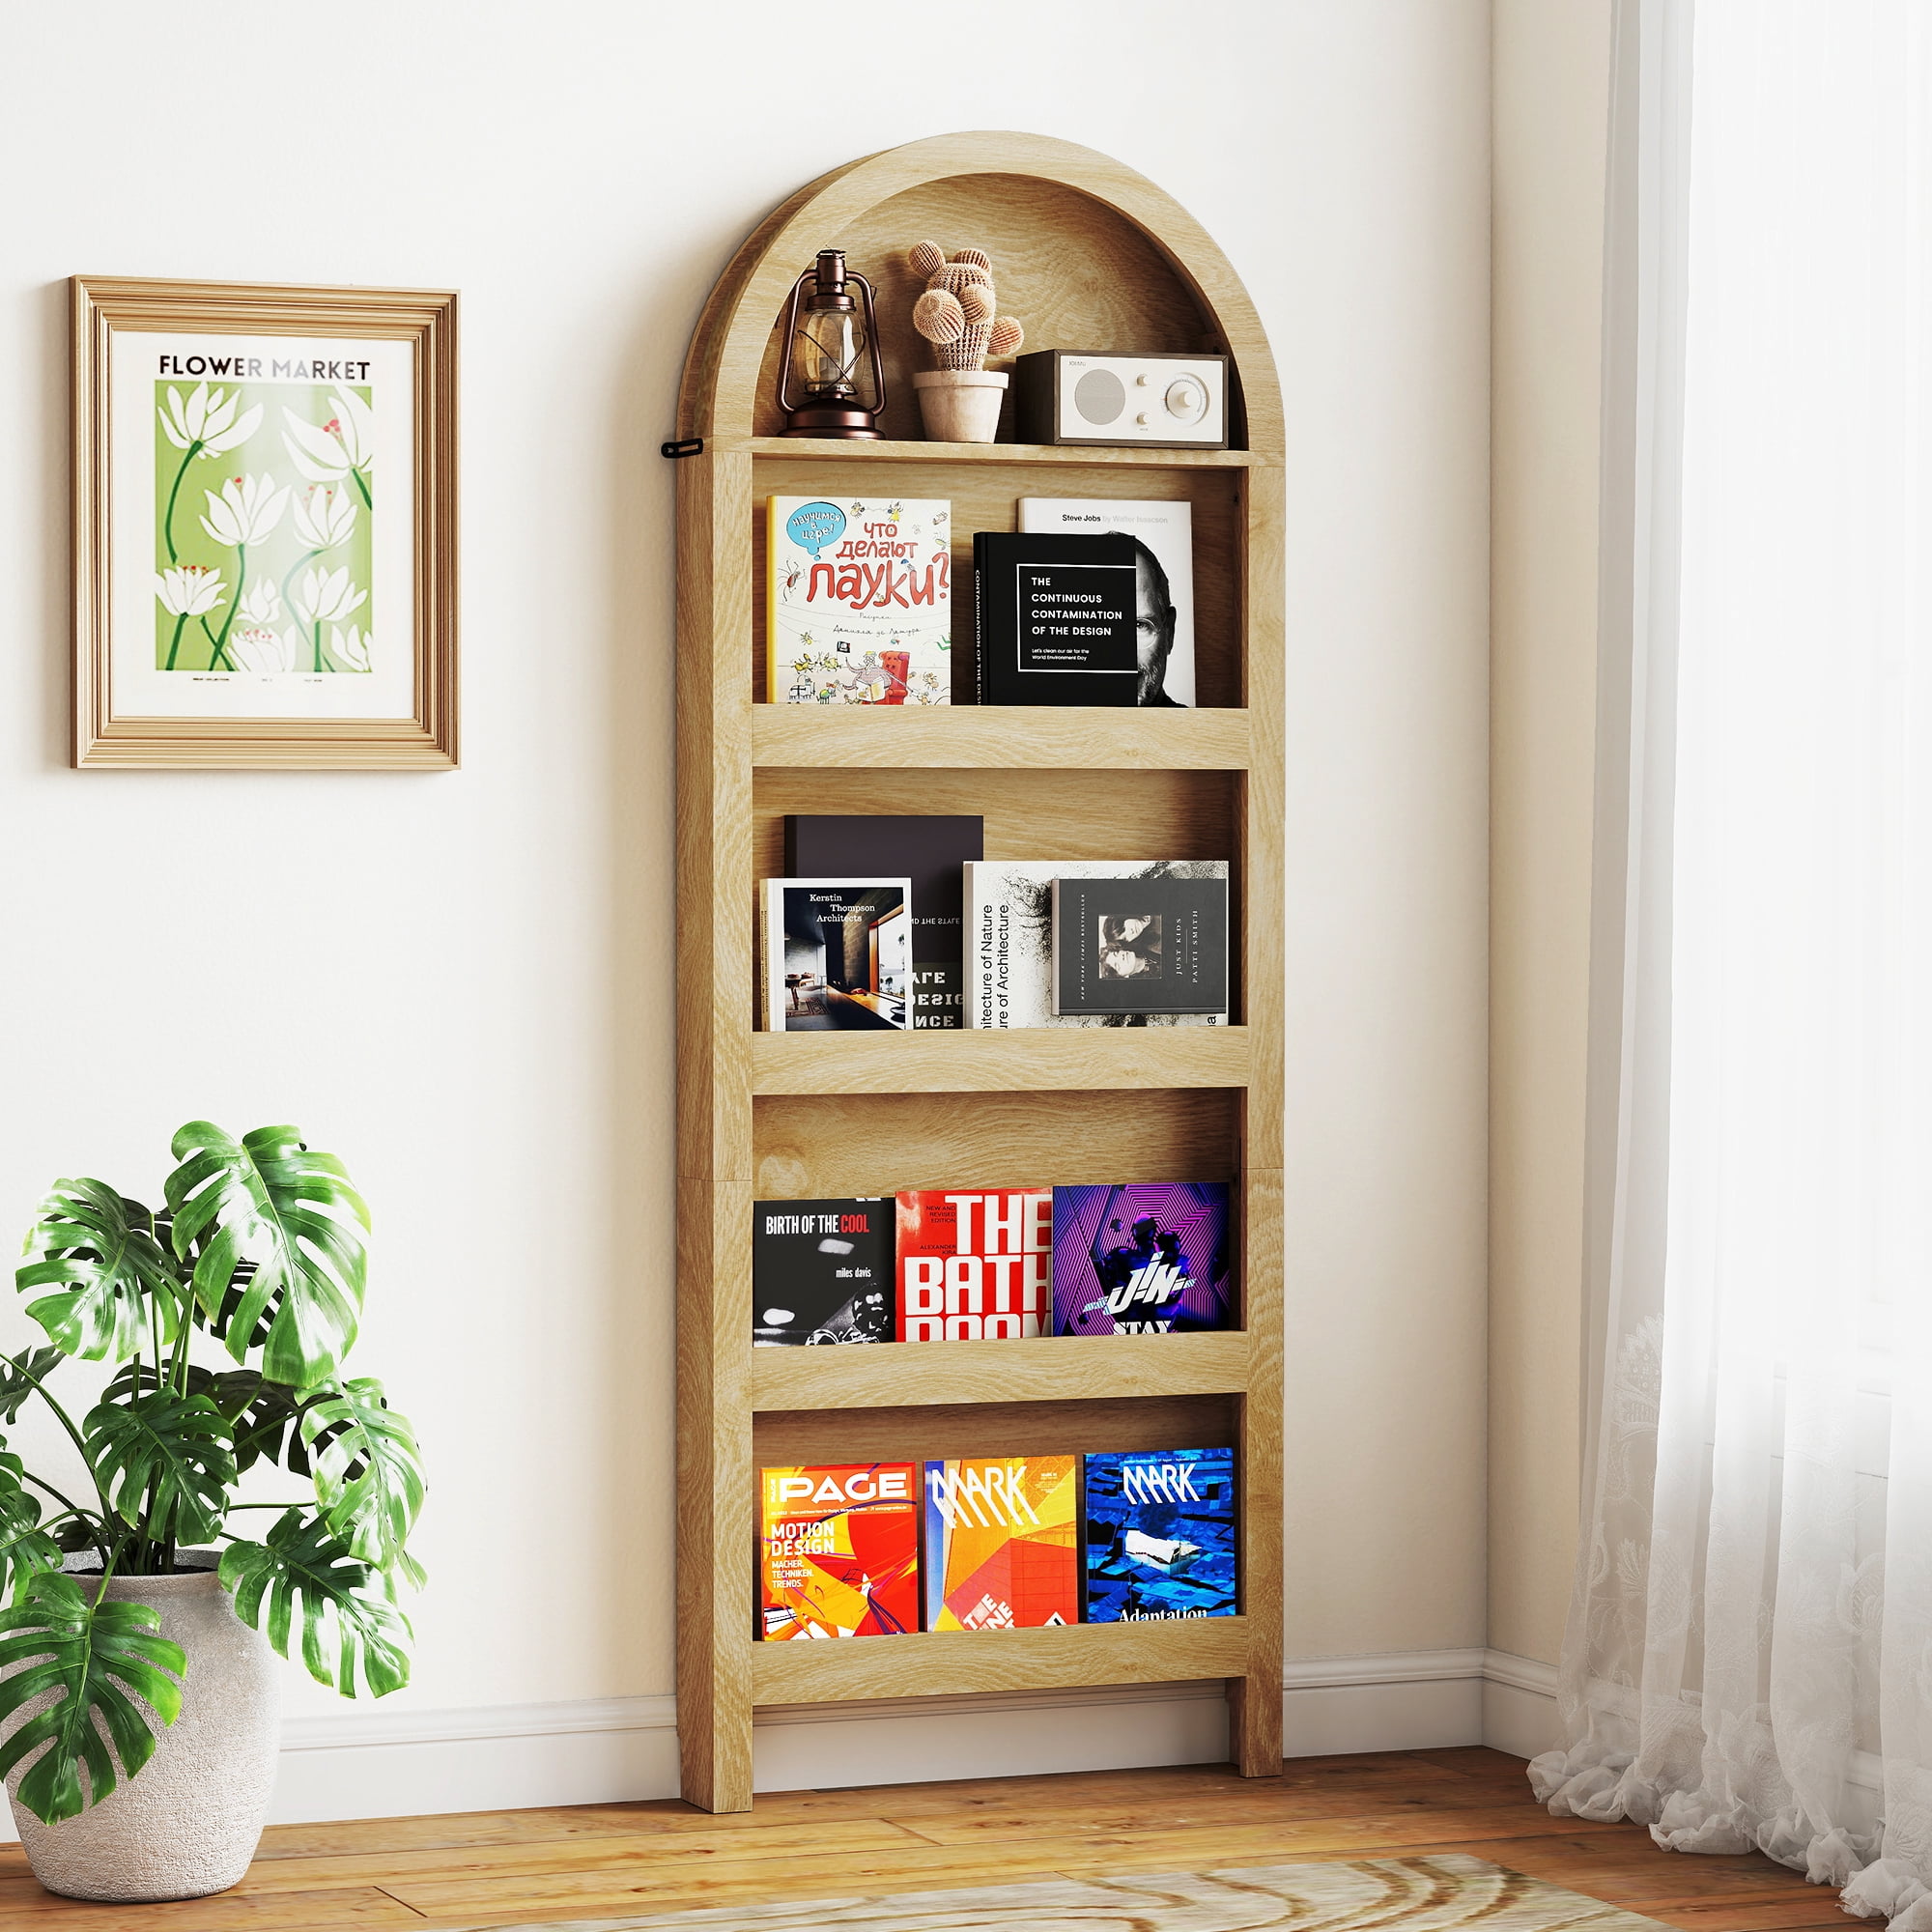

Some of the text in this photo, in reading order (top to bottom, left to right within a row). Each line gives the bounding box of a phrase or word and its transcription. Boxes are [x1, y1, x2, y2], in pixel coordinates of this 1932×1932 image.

[159, 355, 371, 381] FLOWER MARKET
[1031, 577, 1051, 586] THE
[1031, 593, 1102, 604] CONTINUOUS
[1031, 610, 1122, 620] CONTAMINATION
[1032, 626, 1112, 637] OF THE DESIGN
[976, 649, 981, 662] OF
[810, 894, 842, 902] Kerstin
[830, 903, 875, 914] Thompson
[816, 914, 863, 923] Architects
[981, 904, 992, 952] Nature
[997, 904, 1009, 990] Architecture
[980, 954, 992, 969] of
[997, 993, 1009, 1008] of
[766, 1213, 870, 1235] BIRTH OF THE COOL
[944, 1193, 1052, 1255] THE
[836, 1267, 872, 1278] miles davis
[904, 1254, 1052, 1316] BATH
[780, 1472, 907, 1504] PAGE
[1122, 1463, 1201, 1505] MARK
[931, 1465, 1040, 1529] MARK
[771, 1521, 835, 1540] MOTION
[771, 1538, 835, 1557] DESIGN
[772, 1559, 804, 1569] MACHER.
[772, 1569, 814, 1578] TECHNIKEN.
[772, 1579, 804, 1589] TRENDS.
